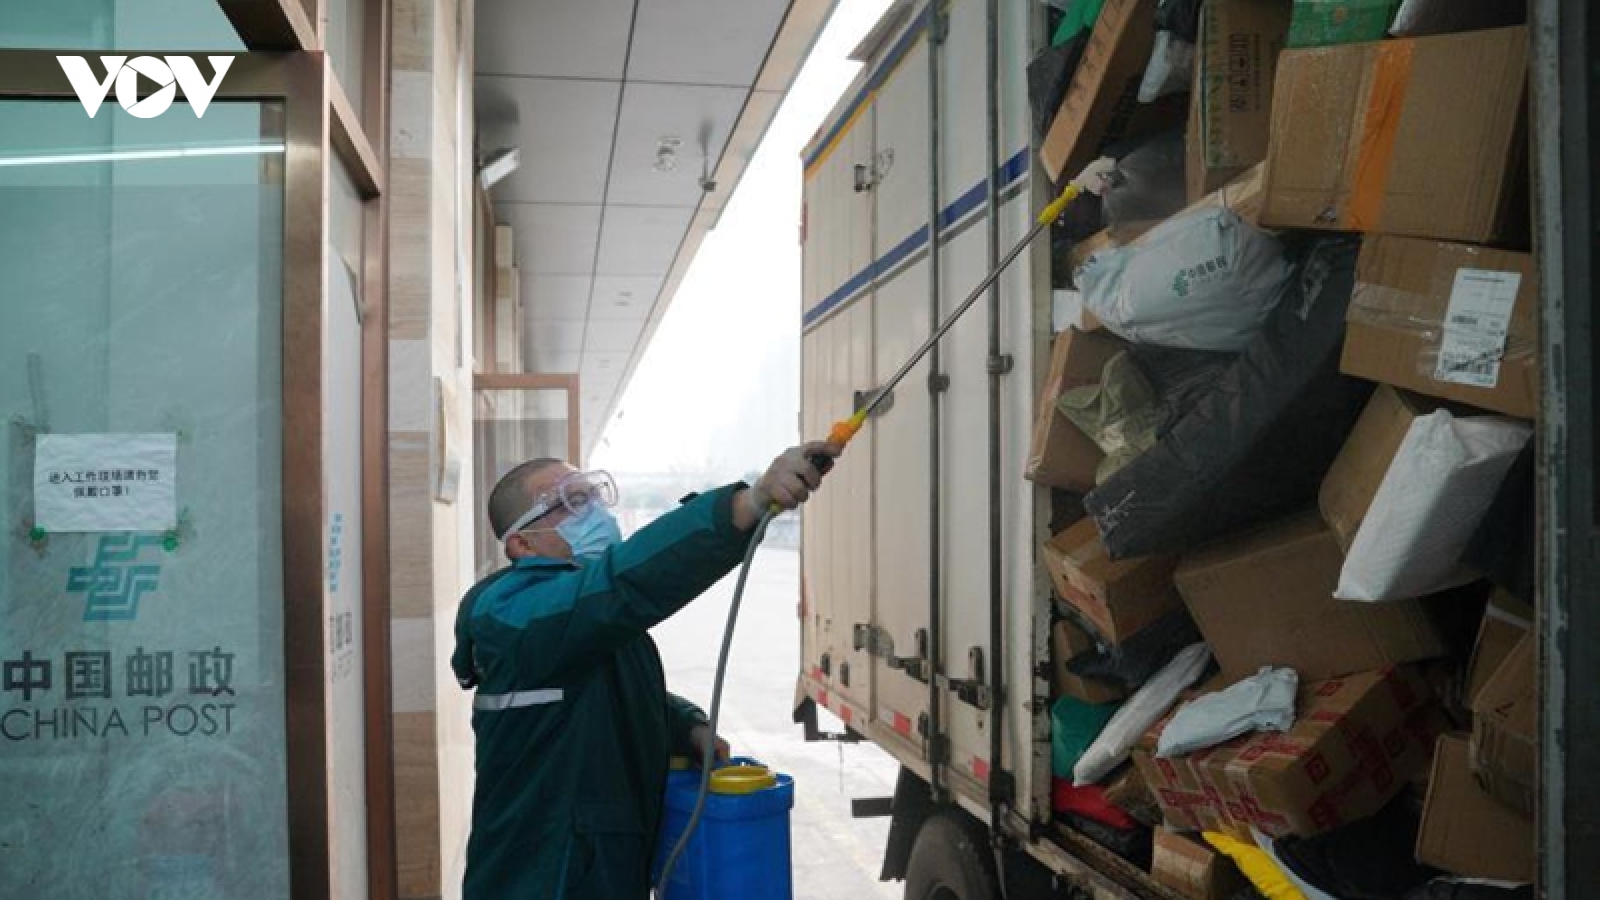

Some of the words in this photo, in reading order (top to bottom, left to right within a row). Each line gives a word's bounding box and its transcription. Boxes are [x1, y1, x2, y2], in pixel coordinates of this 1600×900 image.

[3, 646, 236, 702] 中国邮政
[0, 706, 129, 741] CHINA
[142, 703, 236, 737] POST
